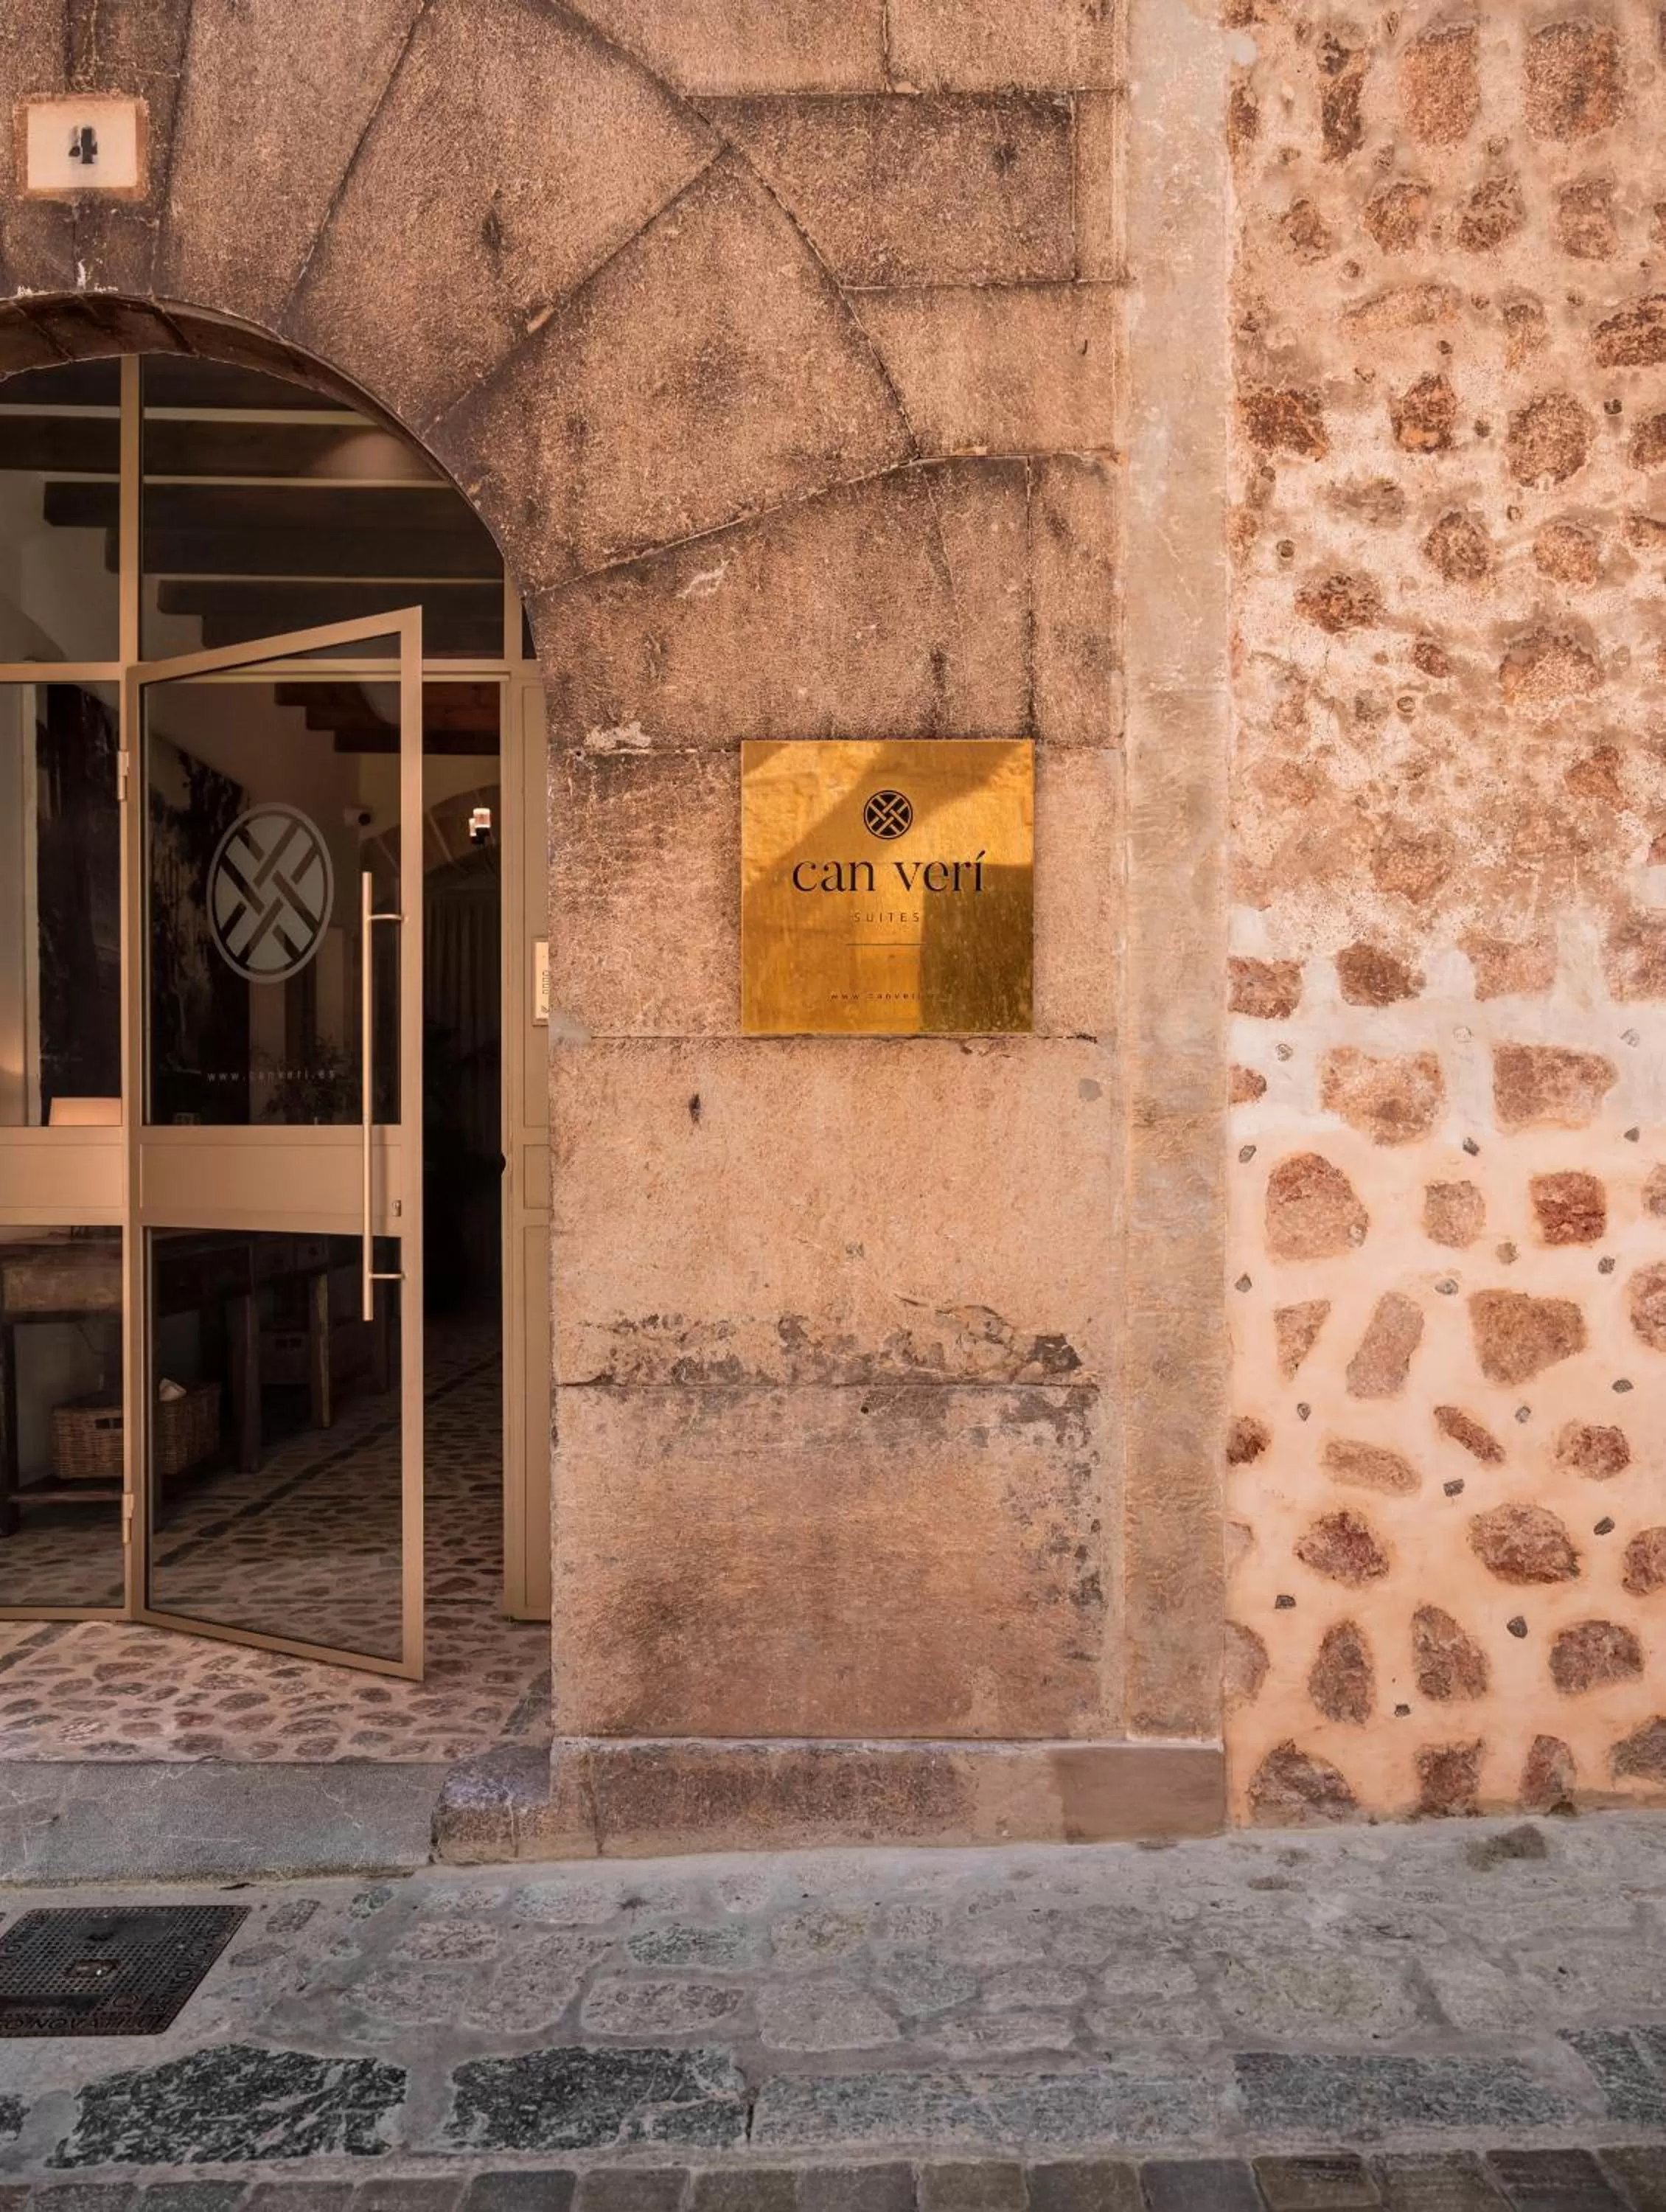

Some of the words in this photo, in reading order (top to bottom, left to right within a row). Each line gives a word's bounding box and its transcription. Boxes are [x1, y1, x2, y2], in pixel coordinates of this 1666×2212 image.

[68, 125, 98, 164] 4
[792, 860, 875, 892] can
[893, 849, 986, 892] verí
[854, 911, 921, 922] SUITES
